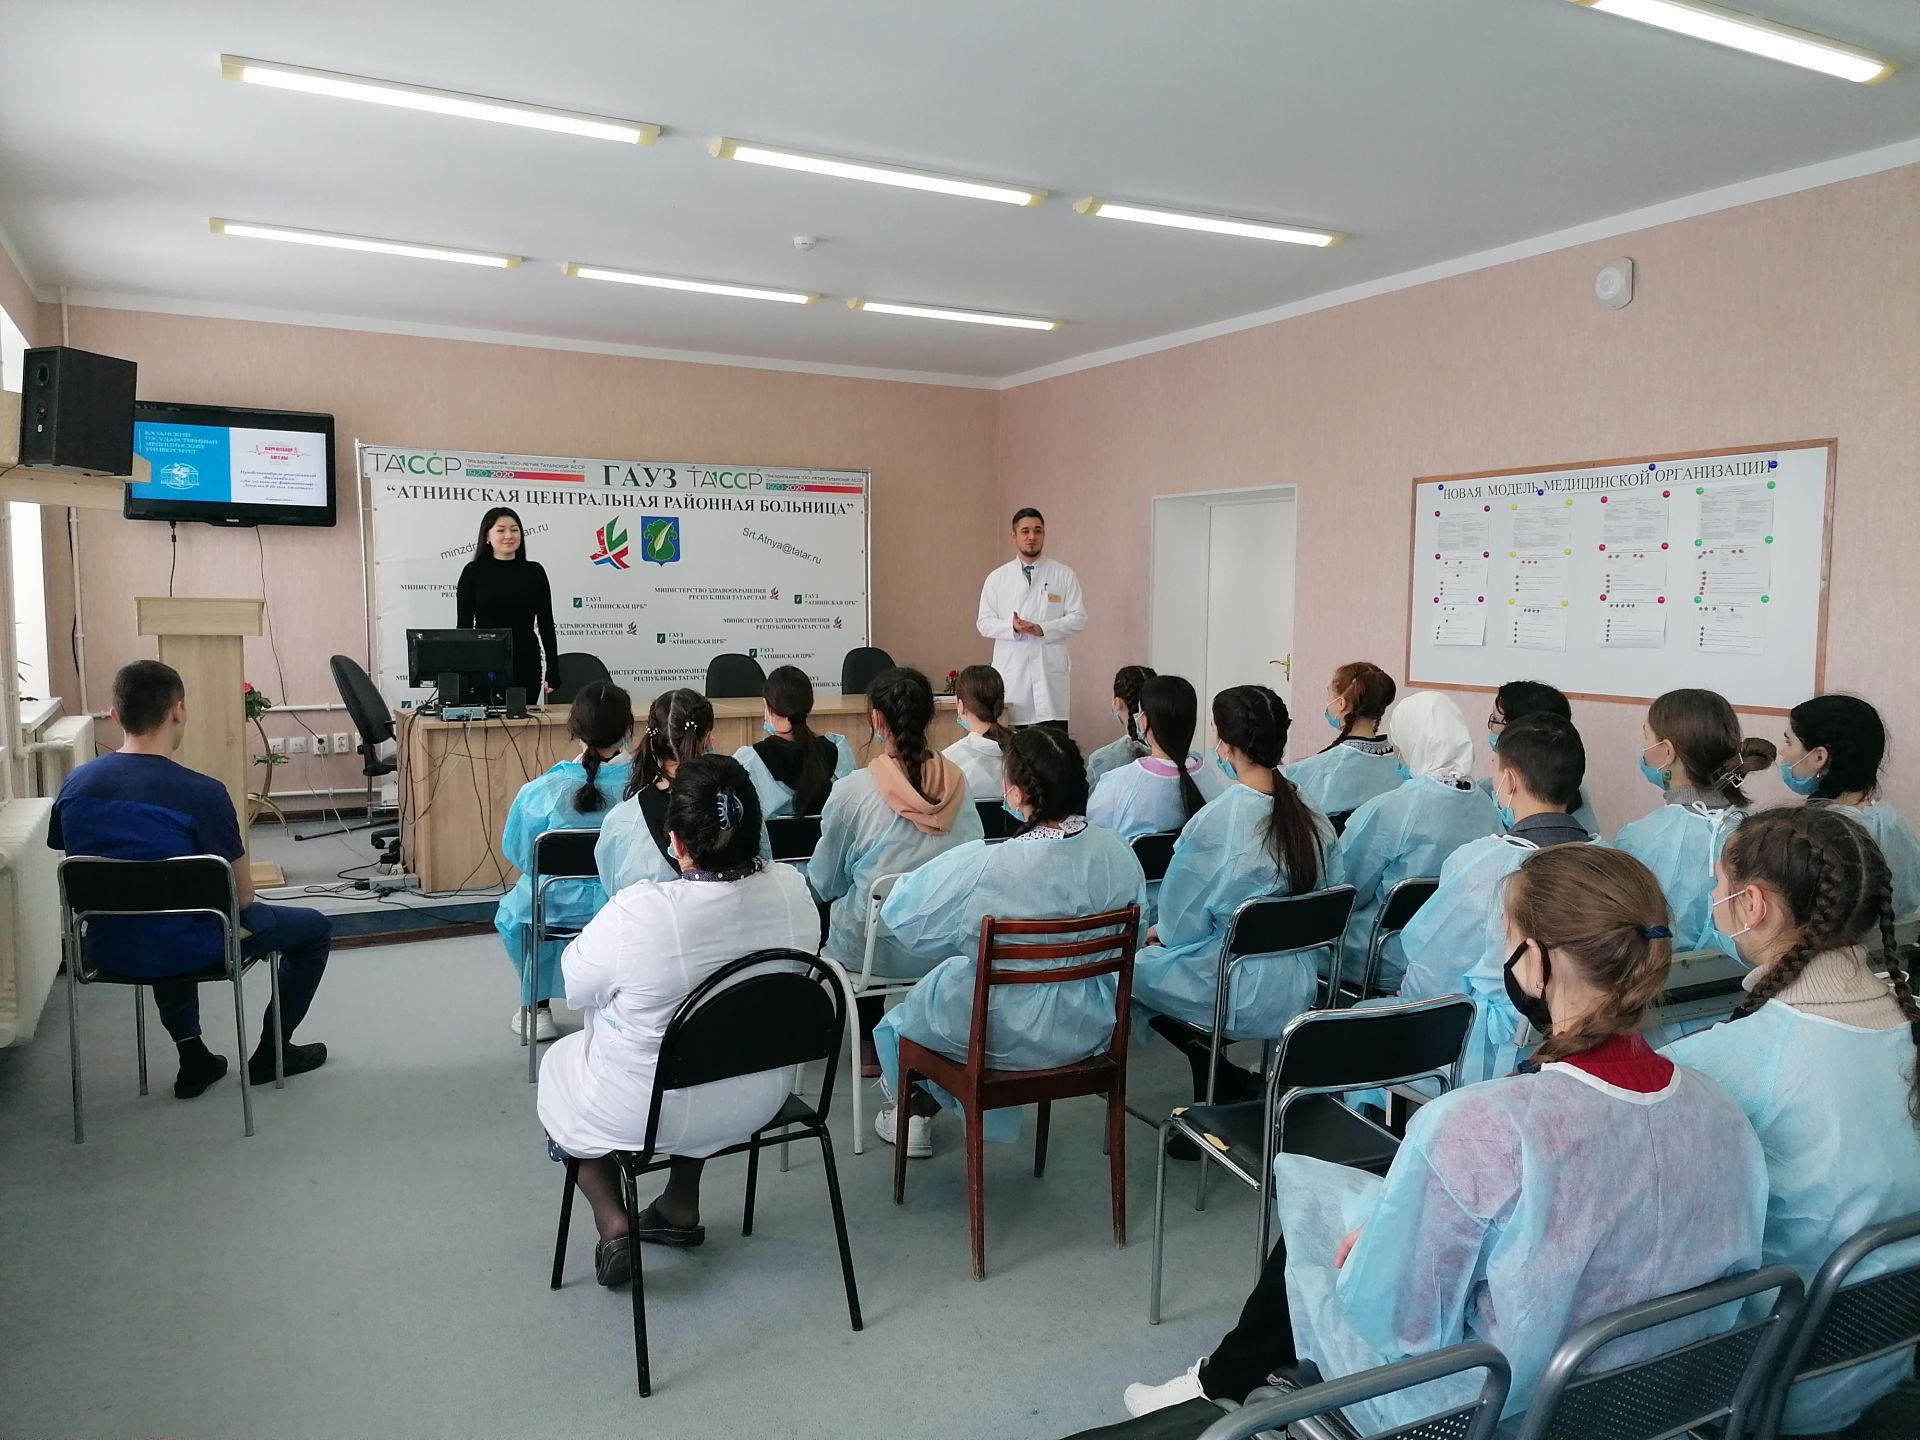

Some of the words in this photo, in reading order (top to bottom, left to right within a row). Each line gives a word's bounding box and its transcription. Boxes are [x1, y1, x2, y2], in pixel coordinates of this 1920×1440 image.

[602, 464, 677, 489] ГАУЗ
[1443, 486, 1483, 500] НОВАЯ
[1488, 482, 1539, 497] МОДЕЛЬ
[1544, 470, 1650, 492] МЕДИЦИНСКОЙ
[1655, 460, 1772, 482] ОРГАНИЗАЦИИ
[526, 490, 658, 508] ЦЕНТРАЛЬНАЯ
[664, 494, 755, 512] РАЙОННАЯ
[742, 527, 822, 565] Srt.Atnya@tatar.ru
